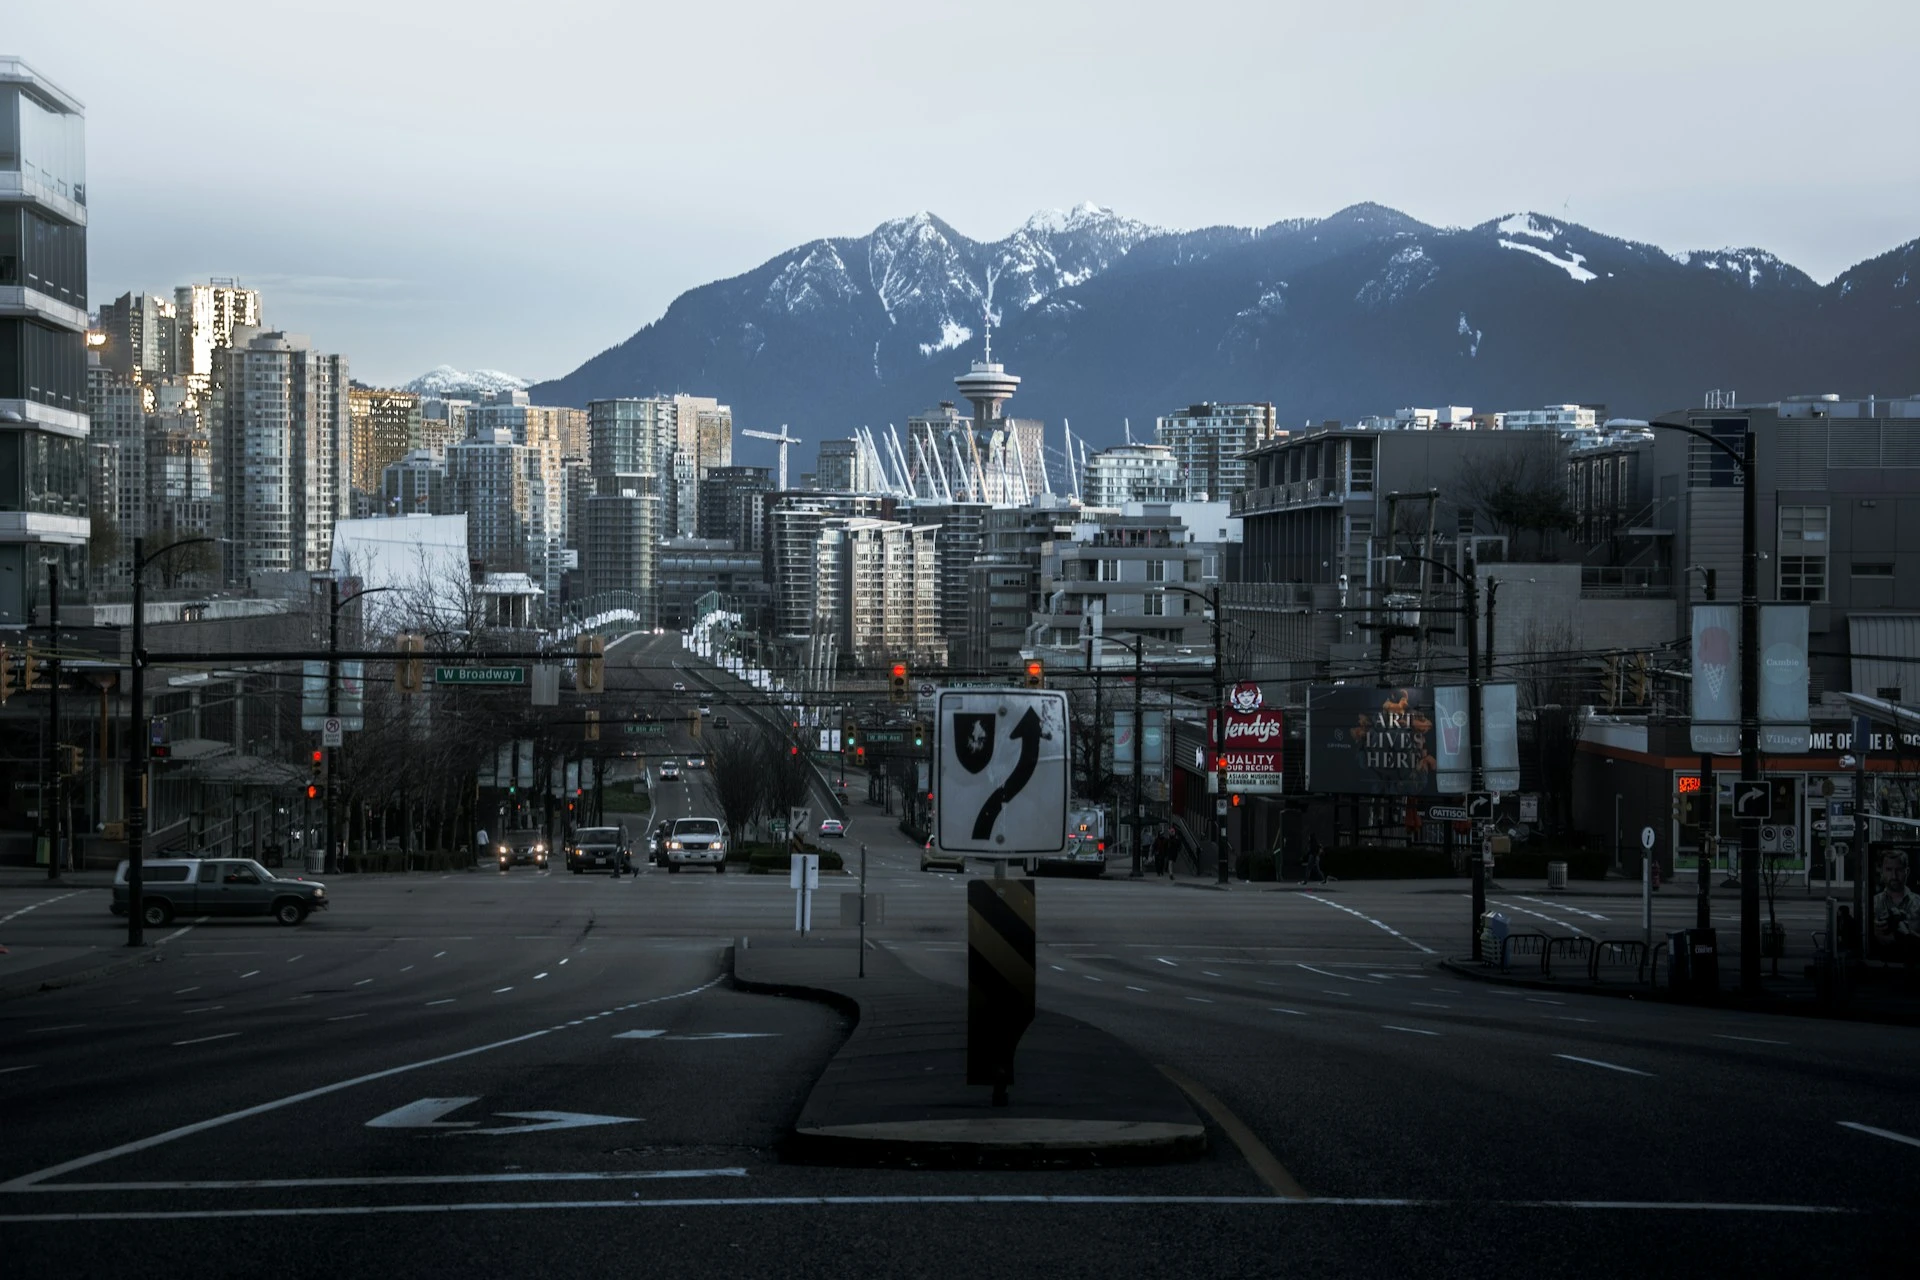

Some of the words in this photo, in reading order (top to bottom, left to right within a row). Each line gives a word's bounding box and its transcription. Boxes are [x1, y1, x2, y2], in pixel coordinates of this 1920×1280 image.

[443, 669, 454, 679] W
[459, 669, 516, 682] Broadway
[1375, 712, 1415, 728] ART
[1366, 731, 1424, 749] LIVES
[1766, 735, 1804, 747] Village
[1216, 755, 1275, 765] UALITY
[1366, 752, 1421, 769] HERE
[1251, 773, 1280, 781] MUSHROOM
[1680, 777, 1700, 786] OPEN
